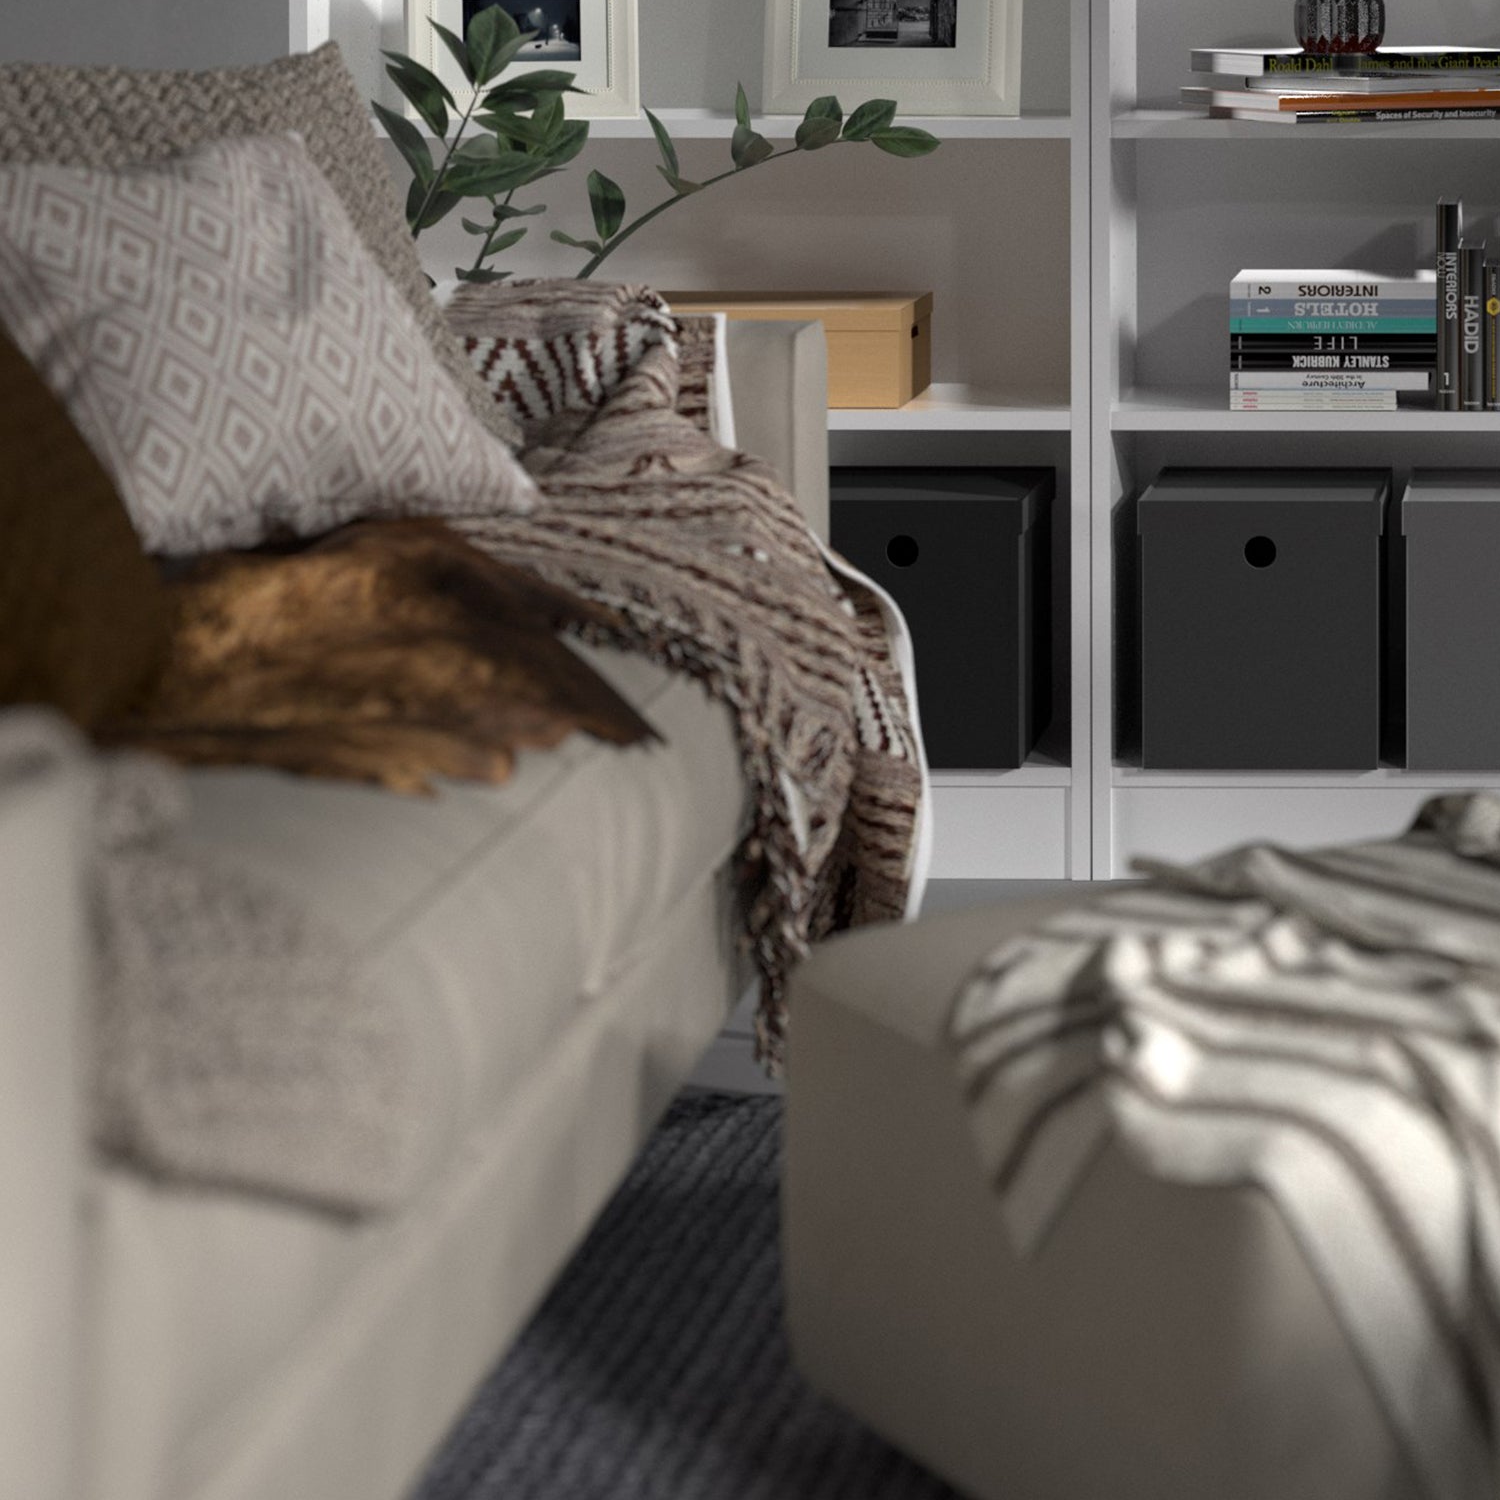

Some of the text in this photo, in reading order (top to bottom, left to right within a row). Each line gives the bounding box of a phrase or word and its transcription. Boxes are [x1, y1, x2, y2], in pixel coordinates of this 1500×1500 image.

[1269, 57, 1333, 72] Roald Dahl
[1394, 57, 1414, 69] and
[1417, 57, 1435, 69] the
[1438, 56, 1471, 68] Giant
[1375, 109, 1497, 120] Spaces of Security and Insecurity
[1258, 286, 1271, 294] 2
[1298, 285, 1378, 297] INTERIORS
[1445, 252, 1457, 320] INTERIORS
[1294, 302, 1379, 316] HOTELS
[1464, 295, 1479, 354] HADID
[1313, 336, 1358, 350] LIFE
[1292, 355, 1390, 368] STANLEY KUBRICK
[1302, 380, 1365, 389] Architecture
[1443, 372, 1450, 386] 1
